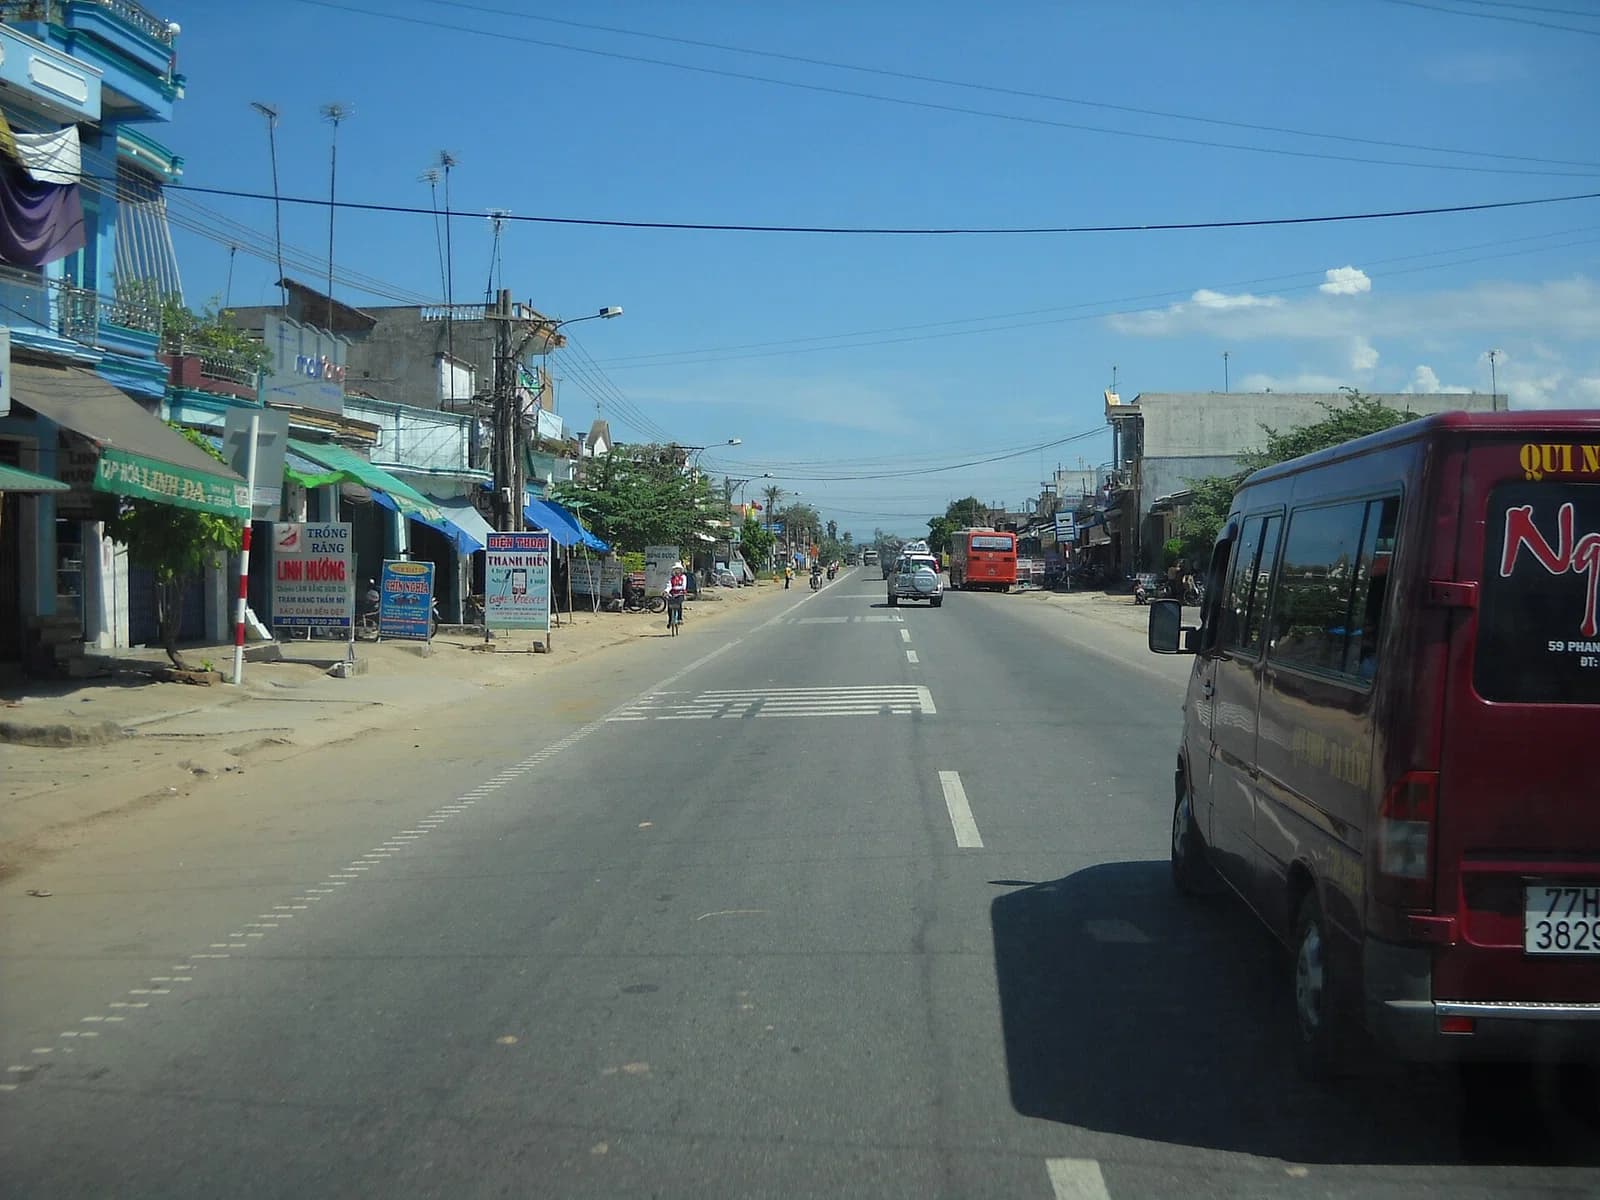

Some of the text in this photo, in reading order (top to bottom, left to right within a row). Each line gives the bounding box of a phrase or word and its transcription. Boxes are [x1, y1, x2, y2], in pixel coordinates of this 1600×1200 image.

[1519, 444, 1574, 481] QUI
[277, 559, 302, 581] LINH
[488, 556, 523, 567] THANH
[1548, 641, 1564, 652] 59
[1545, 888, 1600, 918] 77H
